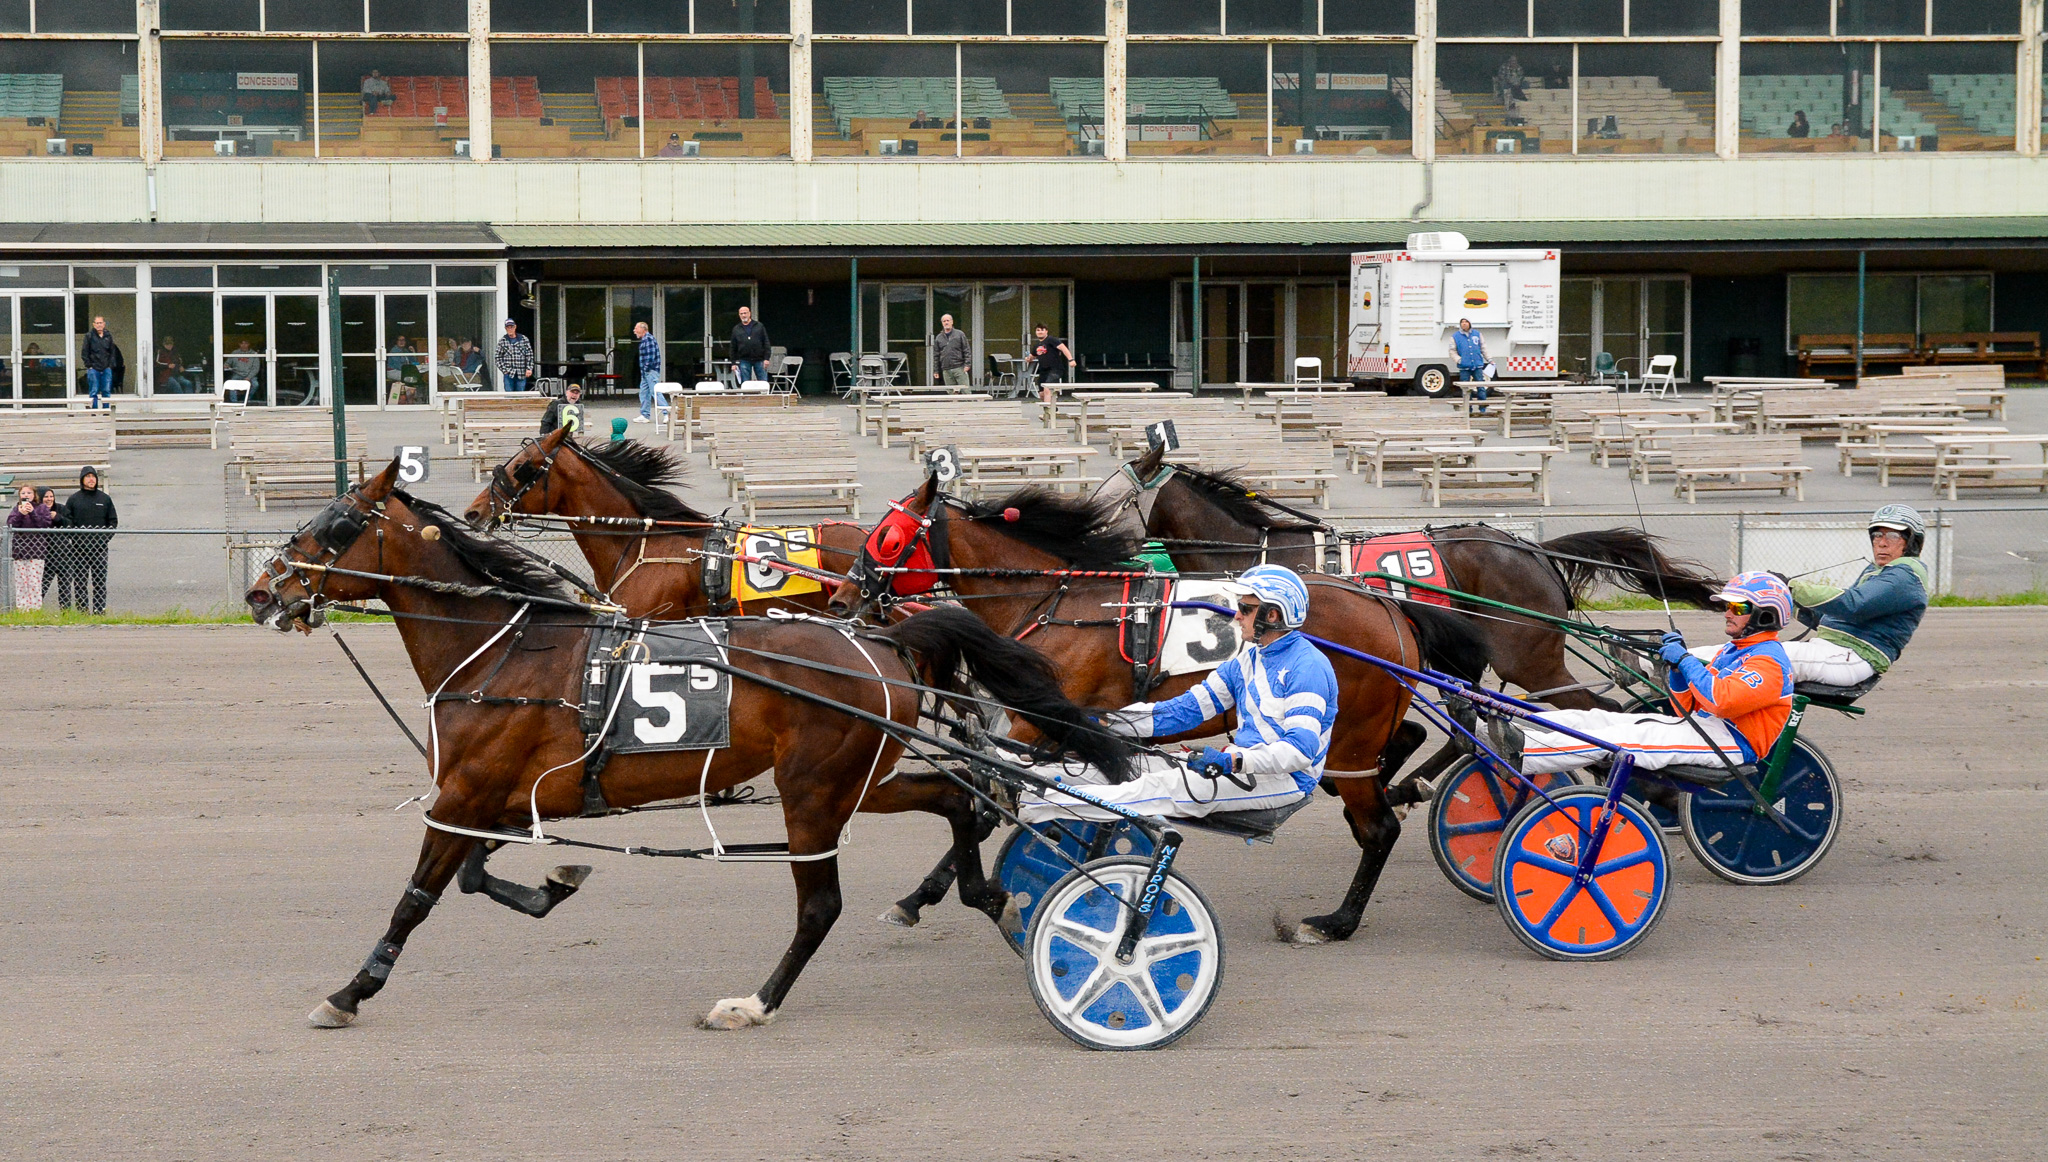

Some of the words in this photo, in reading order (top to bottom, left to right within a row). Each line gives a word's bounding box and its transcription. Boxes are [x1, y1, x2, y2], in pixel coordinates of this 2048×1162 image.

[238, 76, 297, 87] CONCESSIONS
[1333, 76, 1386, 86] RESTROOMS
[562, 405, 580, 432] 6
[1155, 421, 1171, 451] 1
[399, 446, 424, 483] 5
[932, 448, 956, 482] 3
[743, 531, 786, 591] 6
[787, 530, 808, 551] 5
[1378, 552, 1409, 600] 1
[1407, 550, 1434, 578] 5
[1181, 594, 1237, 664] 3
[632, 662, 687, 744] 5
[690, 657, 718, 690] 5
[1057, 782, 1099, 804] STEEVEN
[1138, 845, 1177, 914] NITROUS
